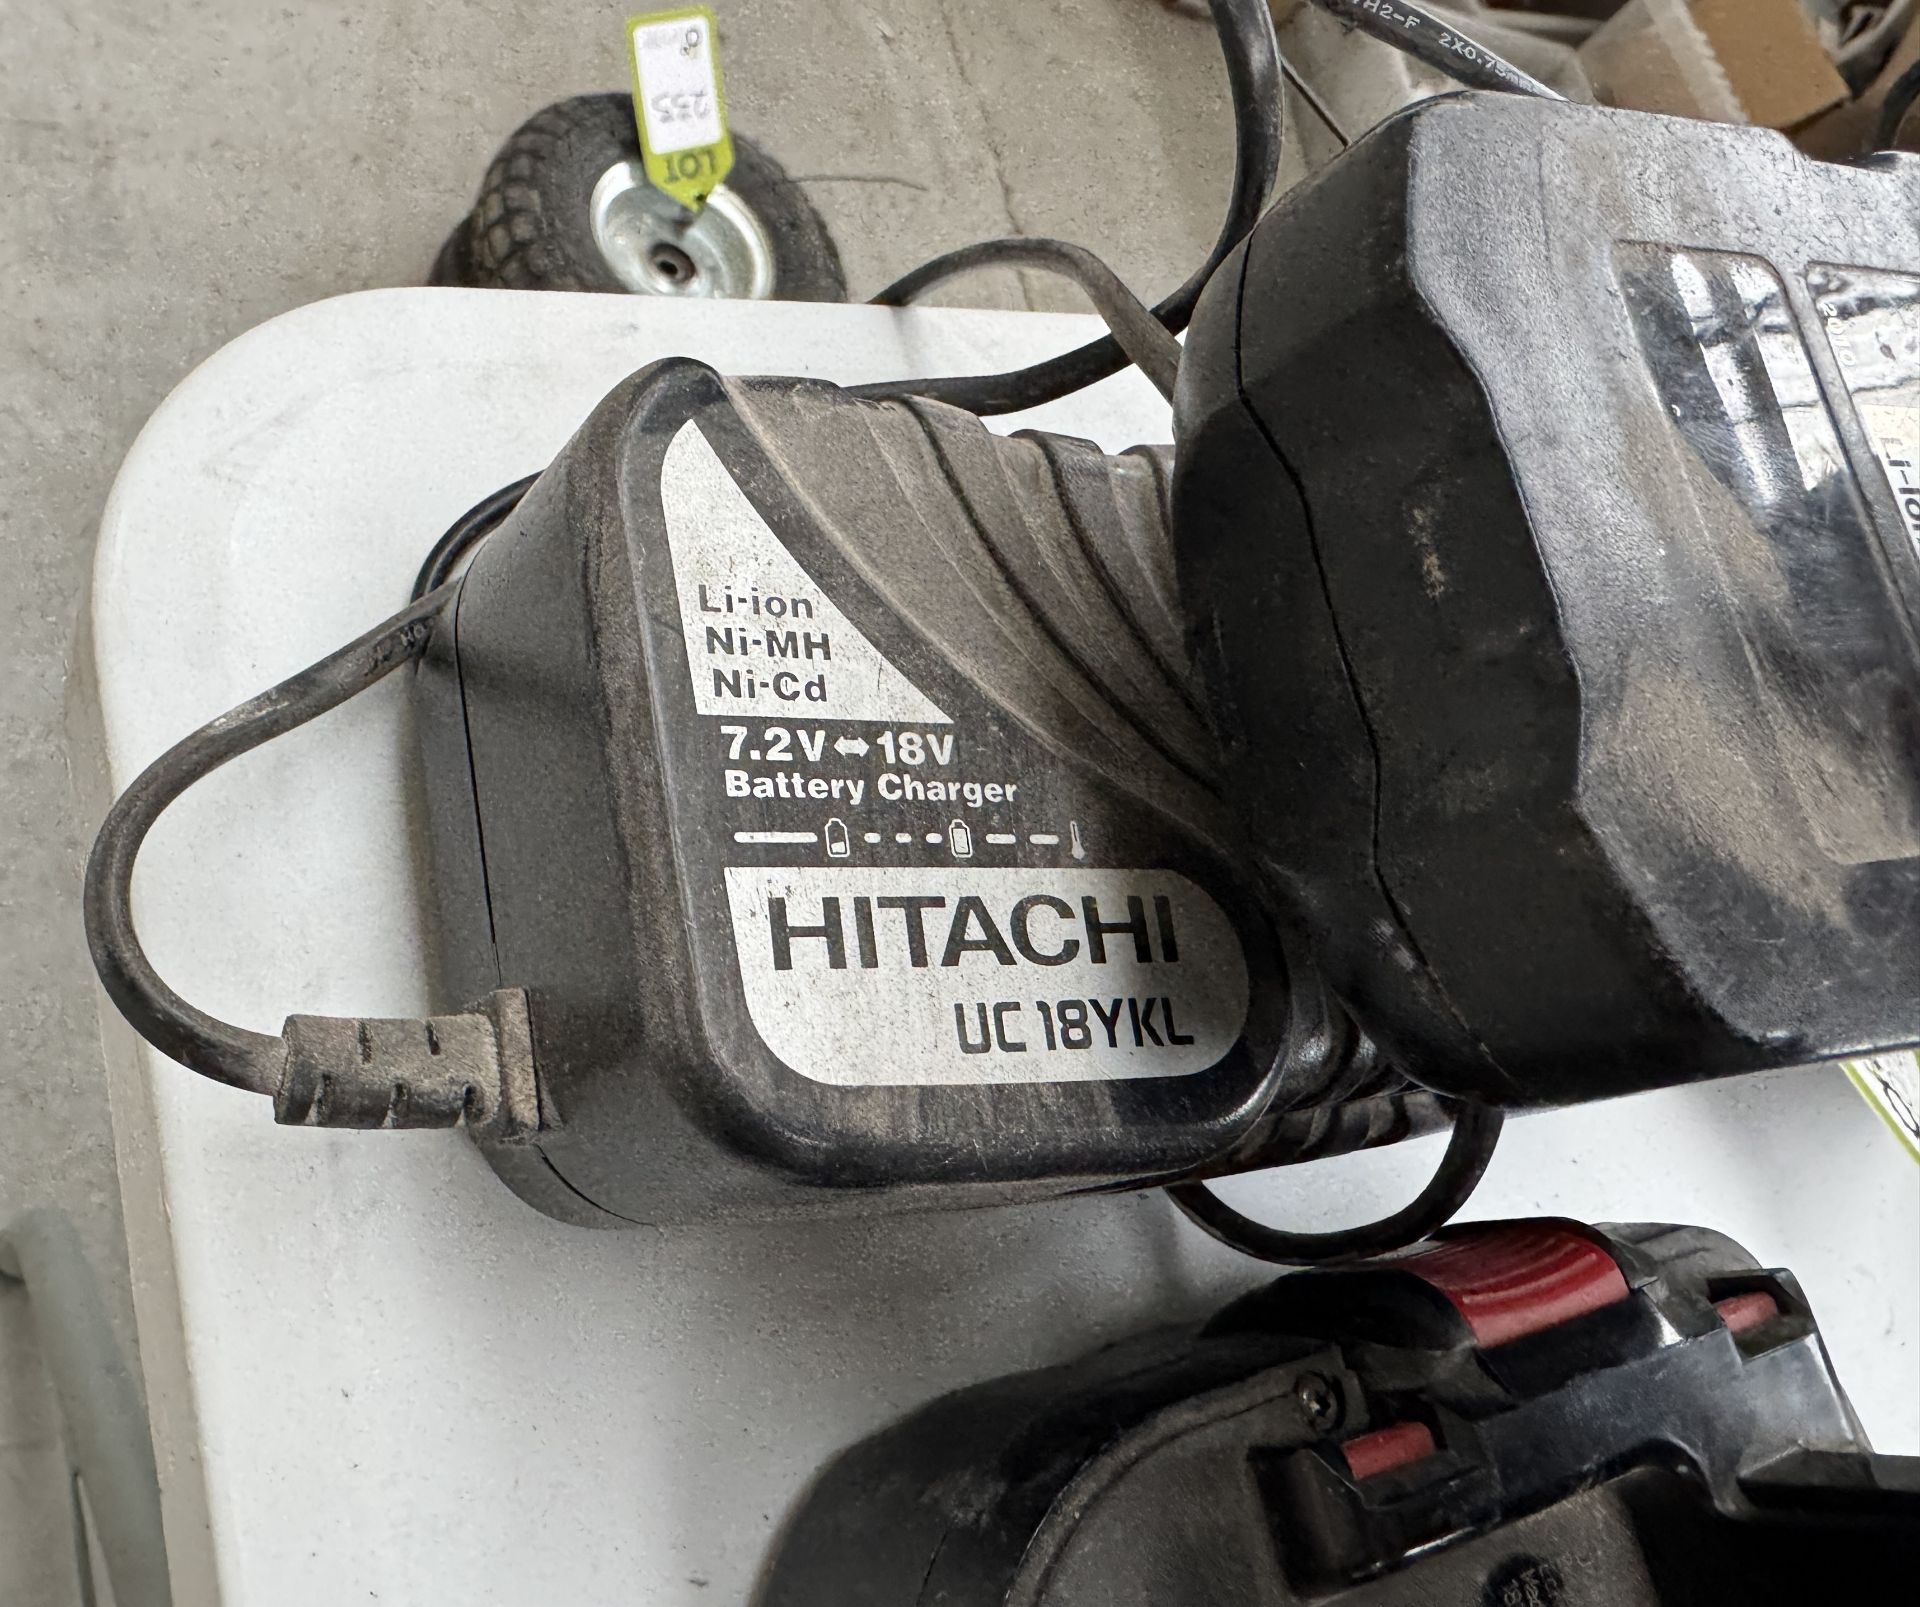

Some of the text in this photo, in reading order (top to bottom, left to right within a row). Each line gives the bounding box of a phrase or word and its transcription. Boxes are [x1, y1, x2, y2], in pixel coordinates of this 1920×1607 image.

[1352, 0, 1420, 29] H2-F
[664, 150, 717, 183] LOT
[698, 584, 813, 619] Li-ion
[705, 626, 832, 661] Ni-MH
[712, 668, 828, 702] Ni-Cd
[720, 725, 954, 766] 7.2V 18V
[724, 769, 1018, 808] Battery Charger
[767, 895, 1179, 971] HITACHI
